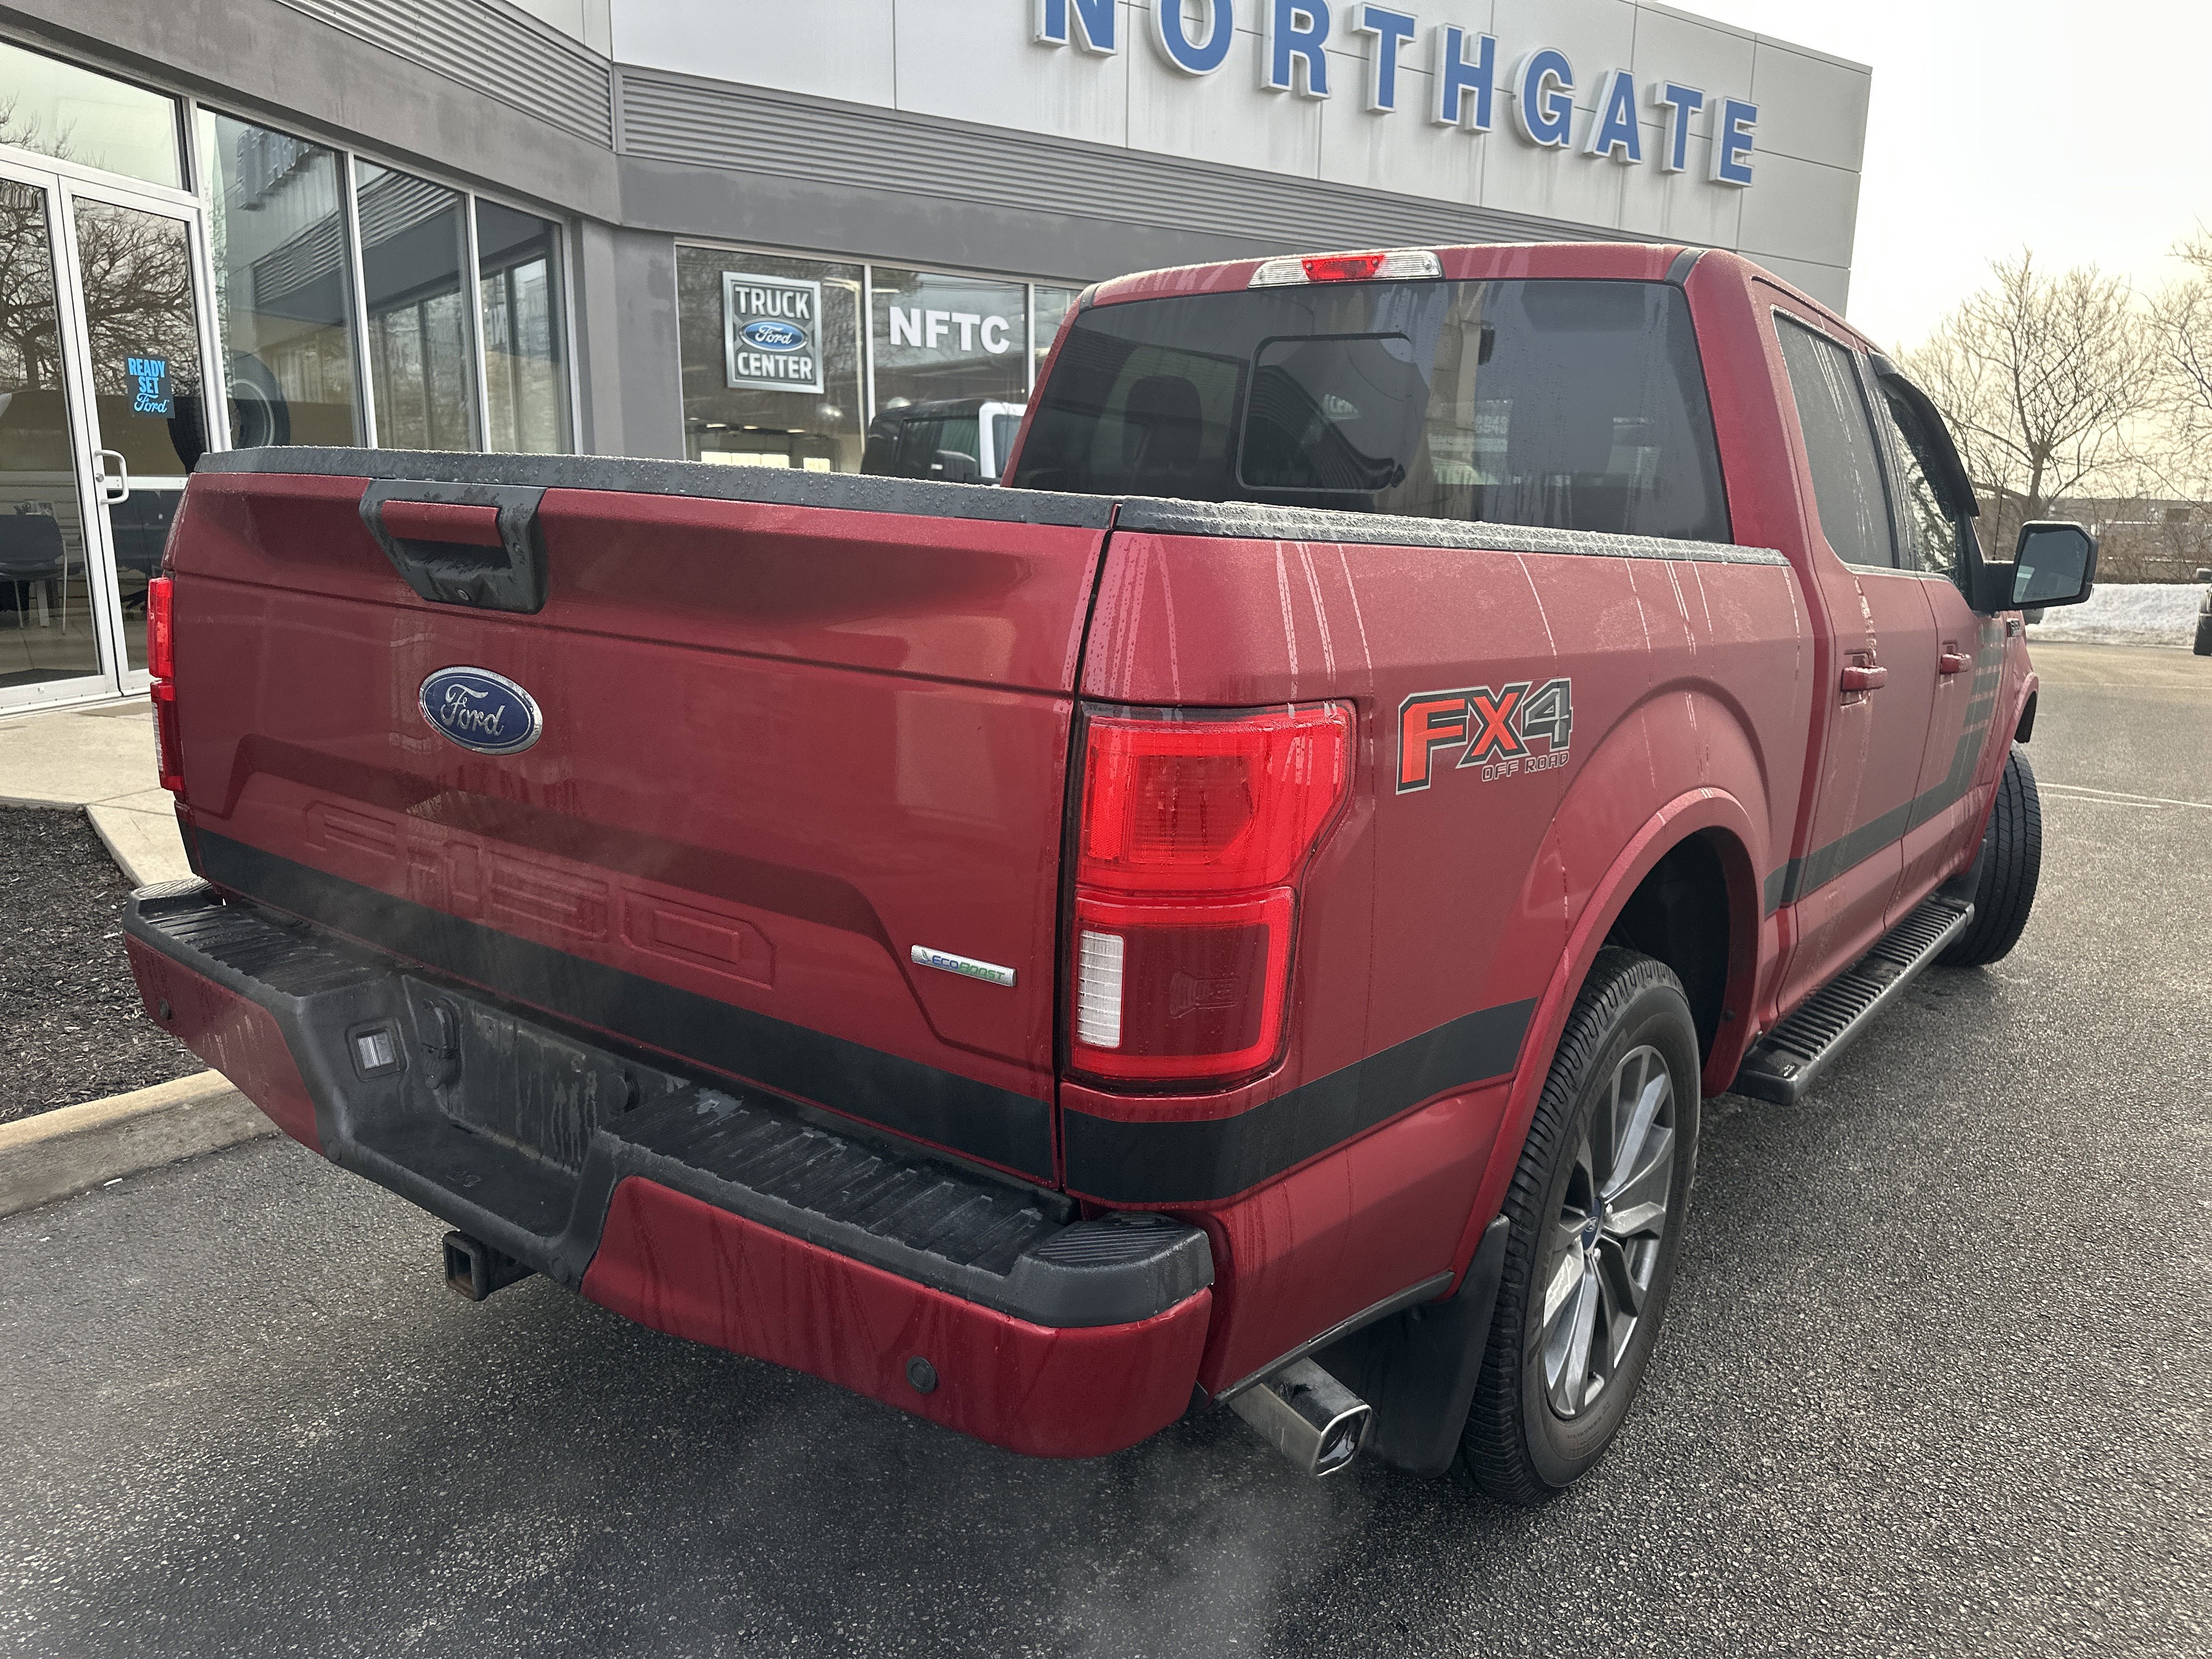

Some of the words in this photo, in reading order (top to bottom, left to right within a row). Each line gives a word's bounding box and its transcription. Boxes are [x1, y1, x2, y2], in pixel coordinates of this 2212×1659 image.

[735, 285, 810, 319] TRUCK
[754, 325, 793, 345] Ford
[889, 306, 1011, 354] NFTC
[128, 358, 165, 378] READY
[737, 352, 812, 380] CENTER
[138, 376, 159, 394] SET
[134, 393, 168, 413] Ford
[440, 684, 505, 737] Ford
[1396, 677, 1573, 795] FX4
[1481, 760, 1519, 782] OFF
[1524, 751, 1570, 774] ROAD
